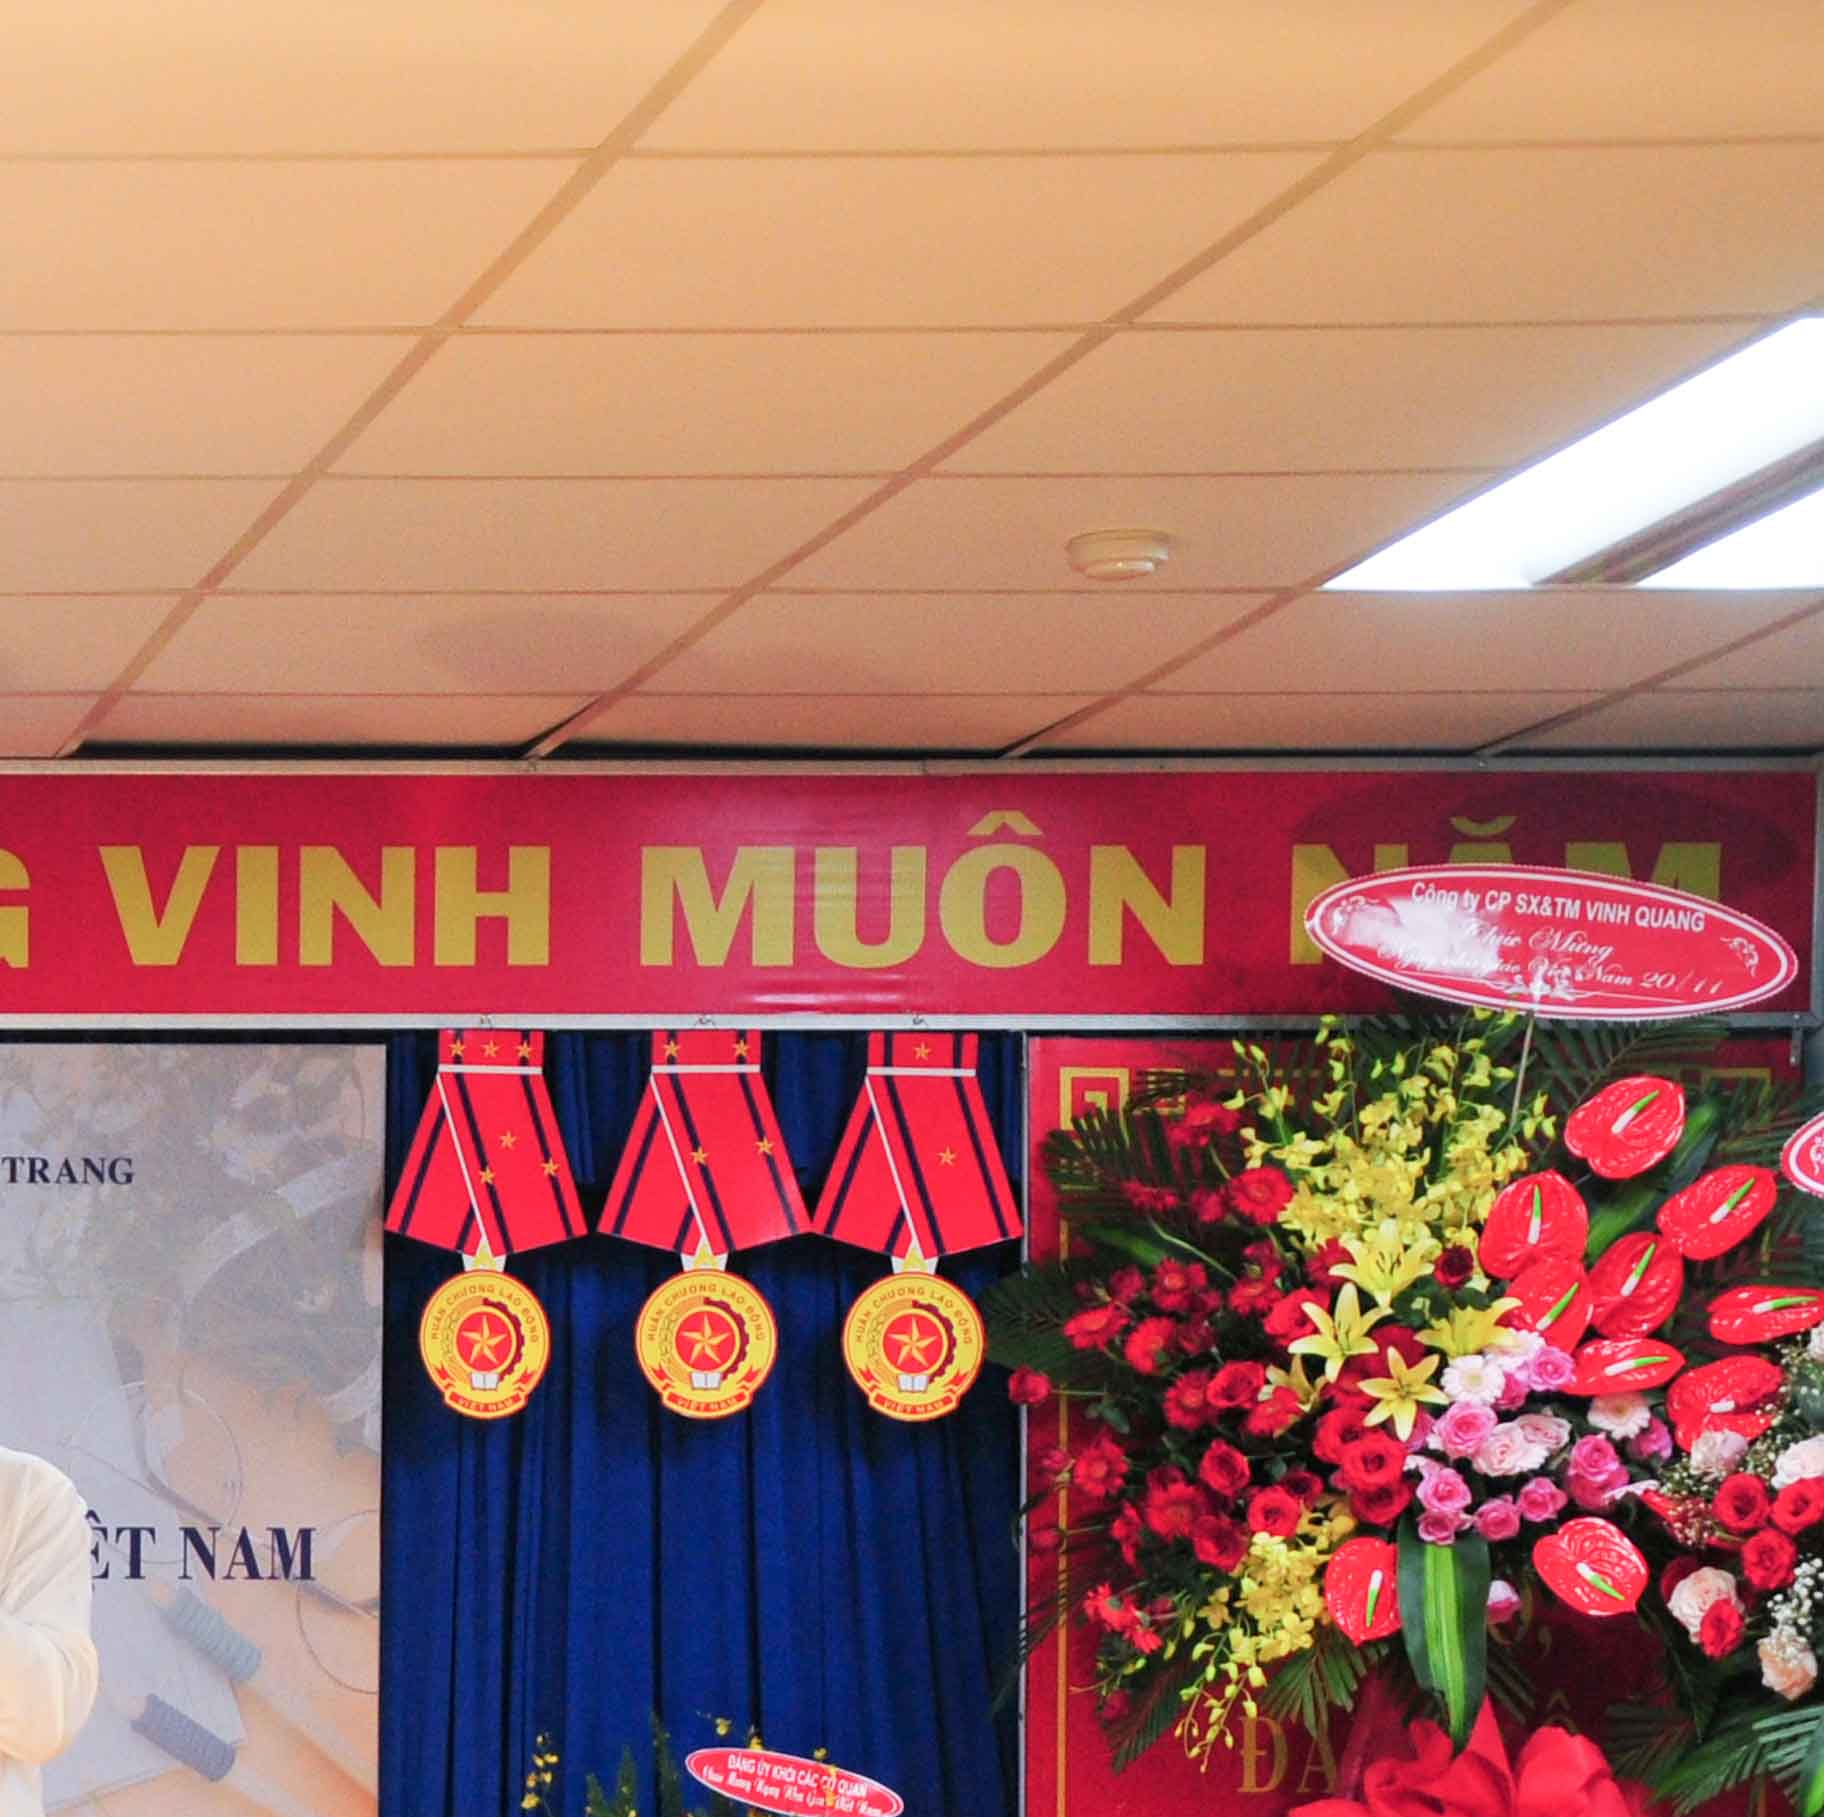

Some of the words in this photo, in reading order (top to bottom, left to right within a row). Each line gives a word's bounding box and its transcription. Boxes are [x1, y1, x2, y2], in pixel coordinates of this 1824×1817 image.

[98, 844, 553, 966] VINH
[638, 810, 1207, 968] MUÔN
[1411, 882, 1457, 911] Công
[1485, 890, 1511, 912] CP
[1514, 893, 1581, 919] SX&TM
[1586, 901, 1631, 926] VINH
[1635, 906, 1706, 934] QUANG
[1, 1156, 134, 1185] TRANG
[178, 1525, 316, 1580] NAM
